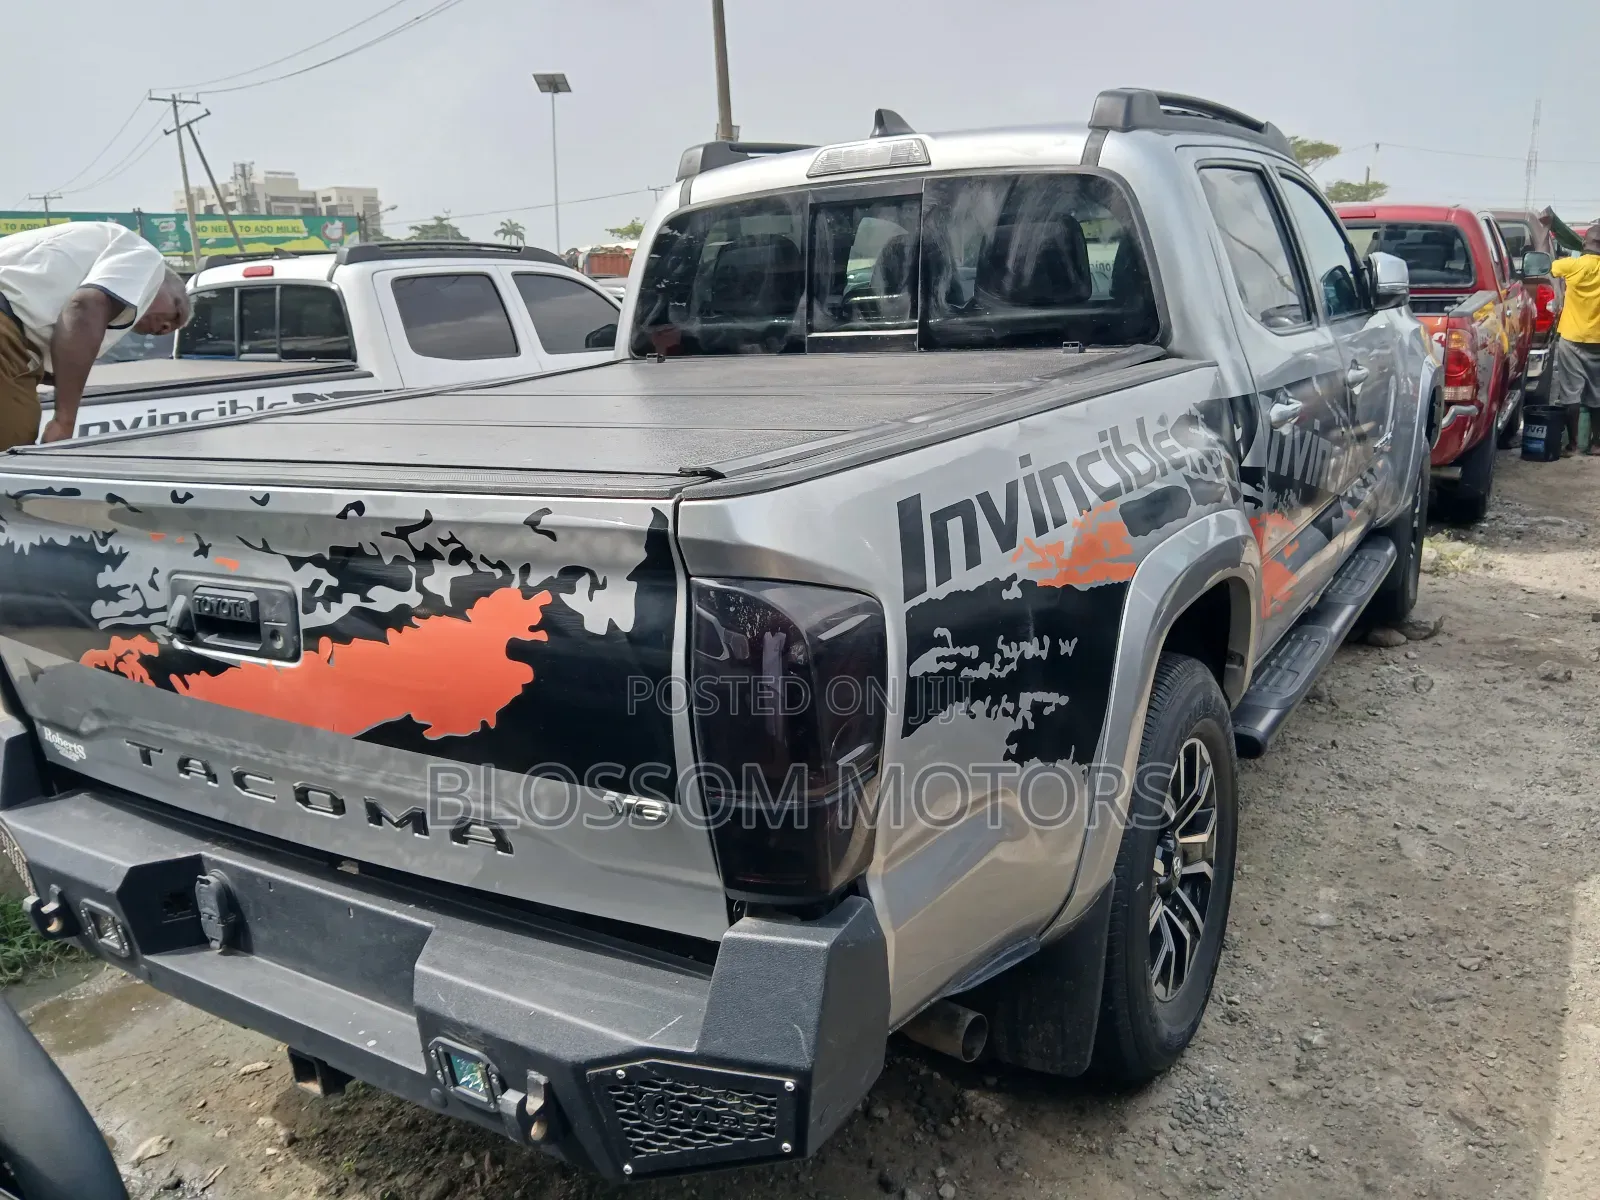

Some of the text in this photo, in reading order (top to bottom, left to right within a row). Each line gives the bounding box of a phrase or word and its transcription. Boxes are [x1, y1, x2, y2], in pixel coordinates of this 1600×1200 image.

[254, 225, 273, 233] ADD
[897, 416, 1187, 604] Invincible
[193, 595, 252, 621] TOYOTA
[124, 738, 515, 856] TACOMA
[602, 789, 669, 825] V6
